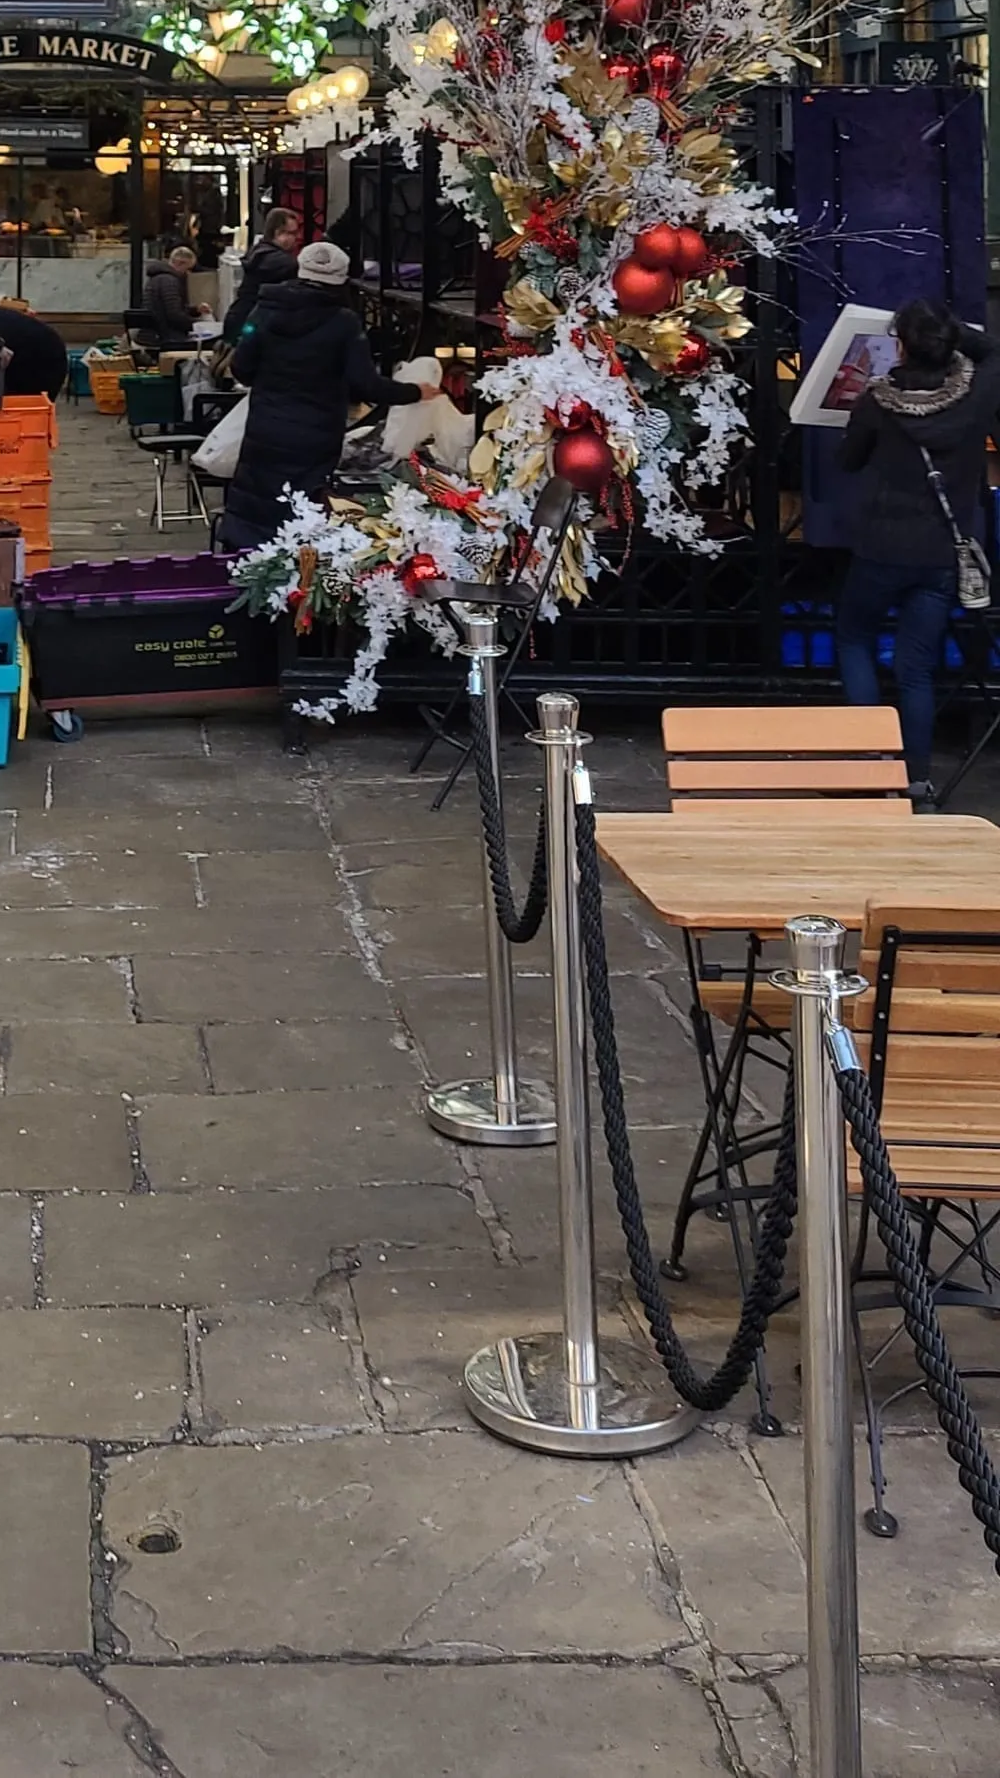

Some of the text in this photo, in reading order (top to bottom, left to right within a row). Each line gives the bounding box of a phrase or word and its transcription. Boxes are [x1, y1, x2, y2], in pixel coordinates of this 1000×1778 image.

[39, 36, 157, 71] MARKET
[135, 641, 170, 652] easy
[173, 639, 207, 650] crate
